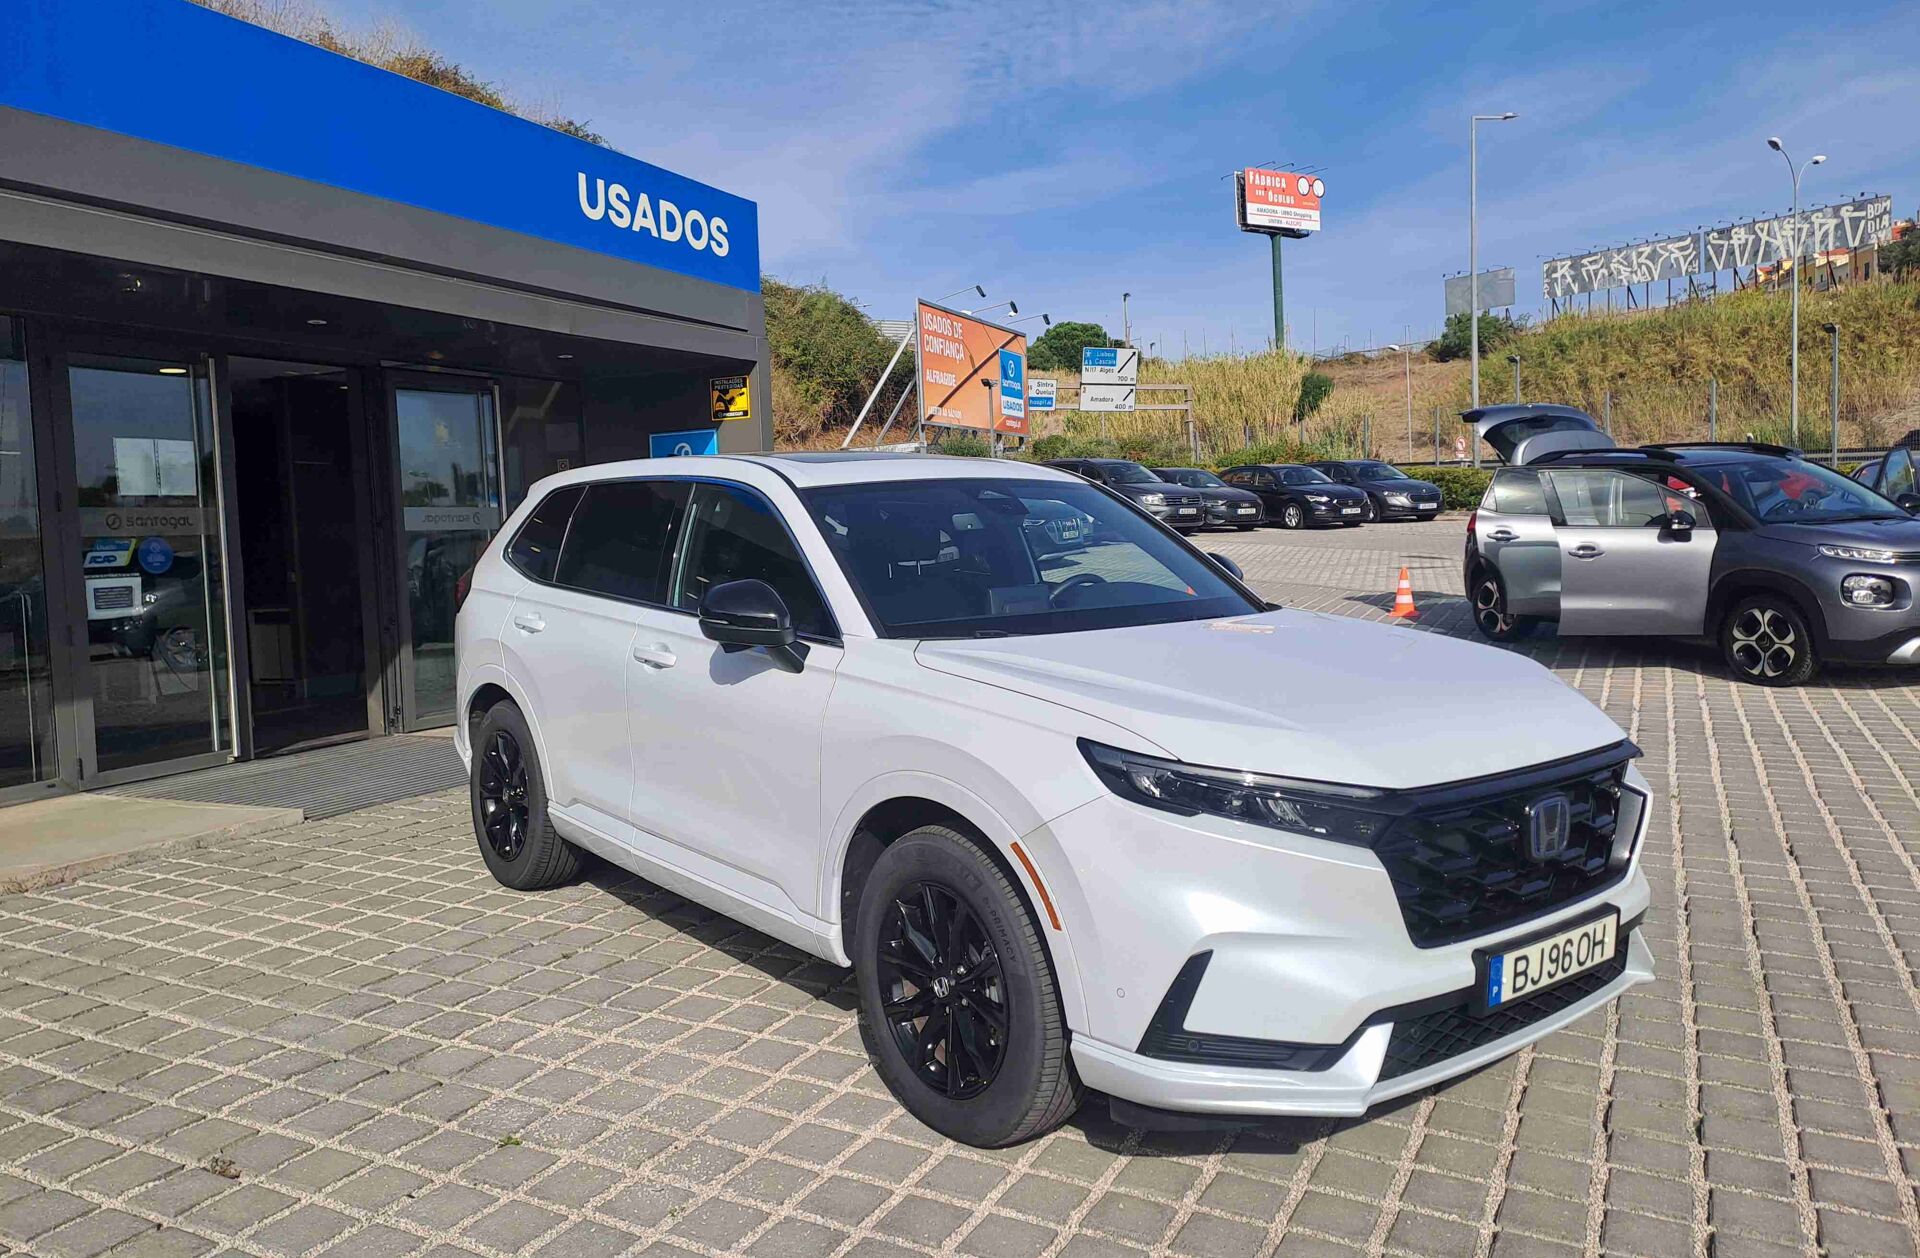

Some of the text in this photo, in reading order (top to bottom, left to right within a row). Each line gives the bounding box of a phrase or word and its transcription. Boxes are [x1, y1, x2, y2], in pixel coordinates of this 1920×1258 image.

[1249, 170, 1287, 189] FÁBRICA
[577, 172, 730, 257] USADOS
[1866, 199, 1891, 220] BOM
[1867, 214, 1890, 234] DIA
[922, 311, 963, 340] USADOS DE
[924, 333, 965, 364] CONFIANÇA
[1003, 400, 1023, 412] USADOS
[1492, 986, 1498, 997] P
